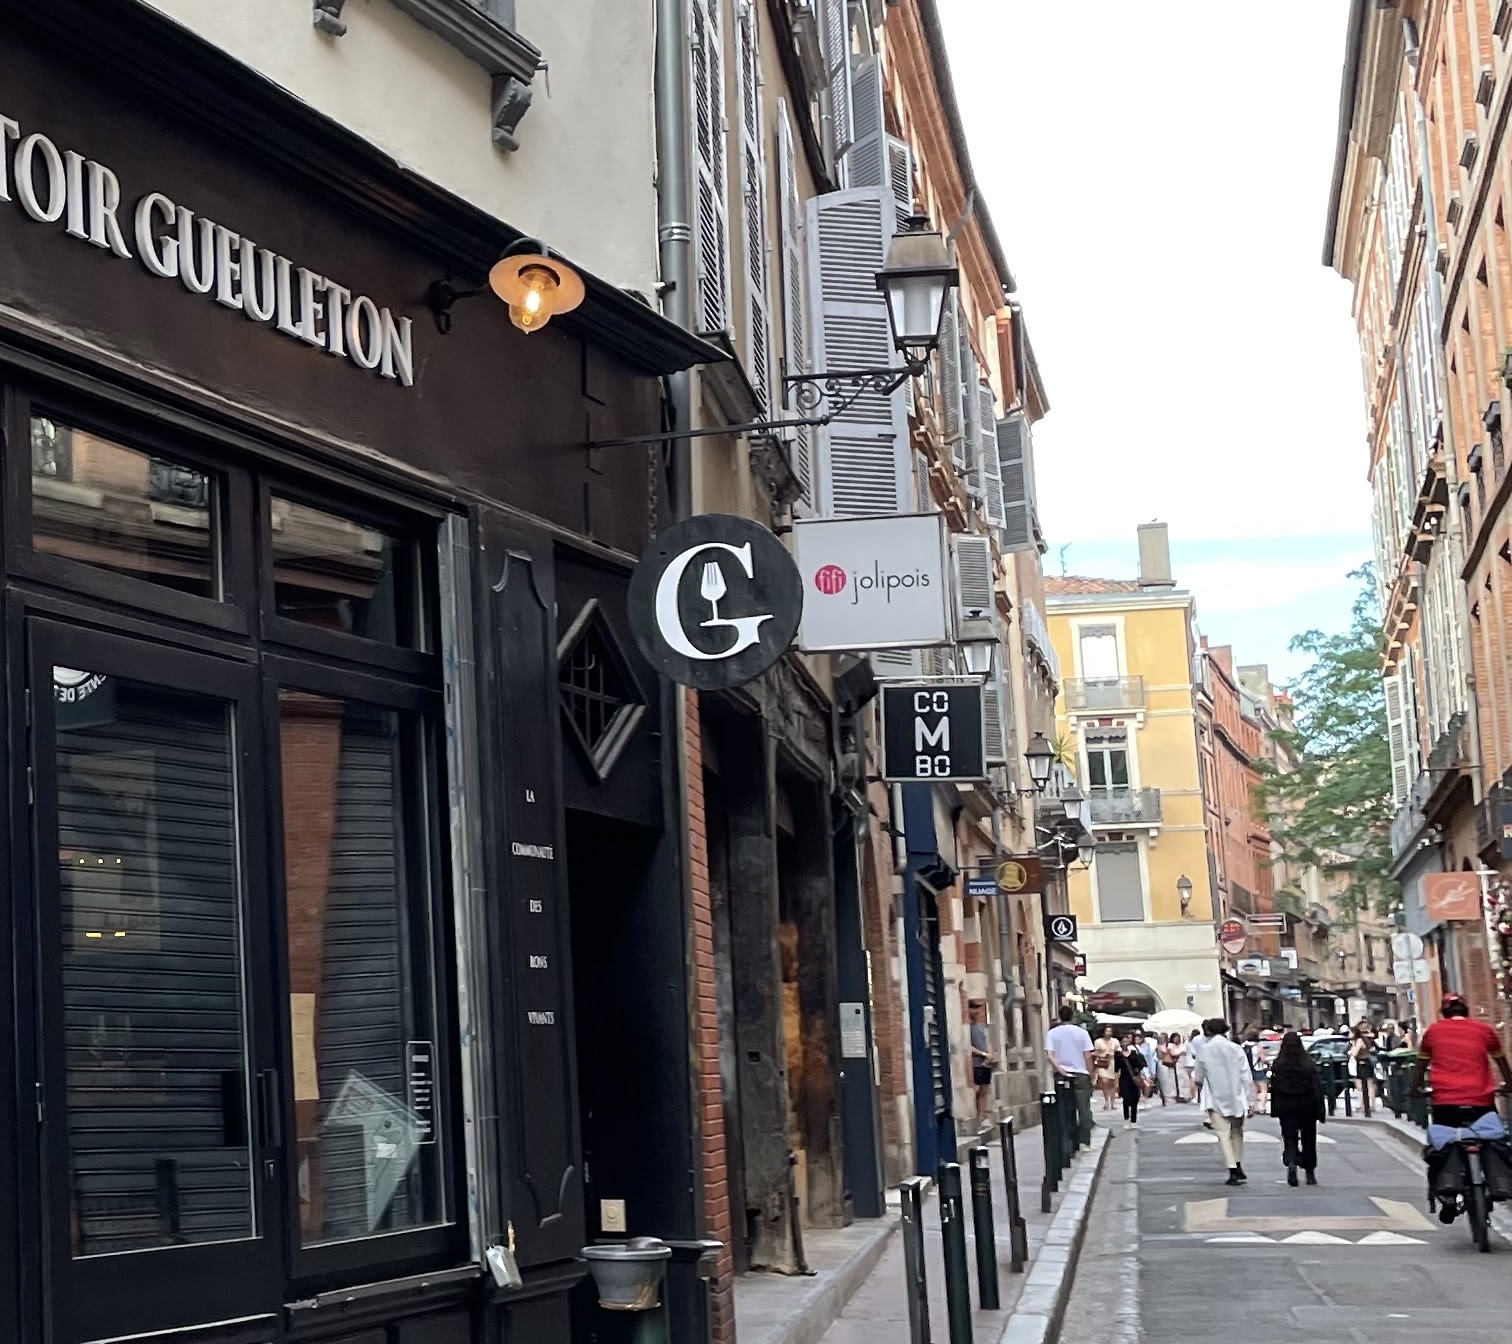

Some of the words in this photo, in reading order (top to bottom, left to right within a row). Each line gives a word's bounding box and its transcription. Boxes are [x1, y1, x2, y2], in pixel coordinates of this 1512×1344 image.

[135, 192, 413, 387] GUEULETON
[655, 542, 774, 660] G
[851, 560, 929, 605] jolipois
[914, 691, 949, 713] CO
[915, 716, 950, 752] M
[915, 755, 950, 777] BO
